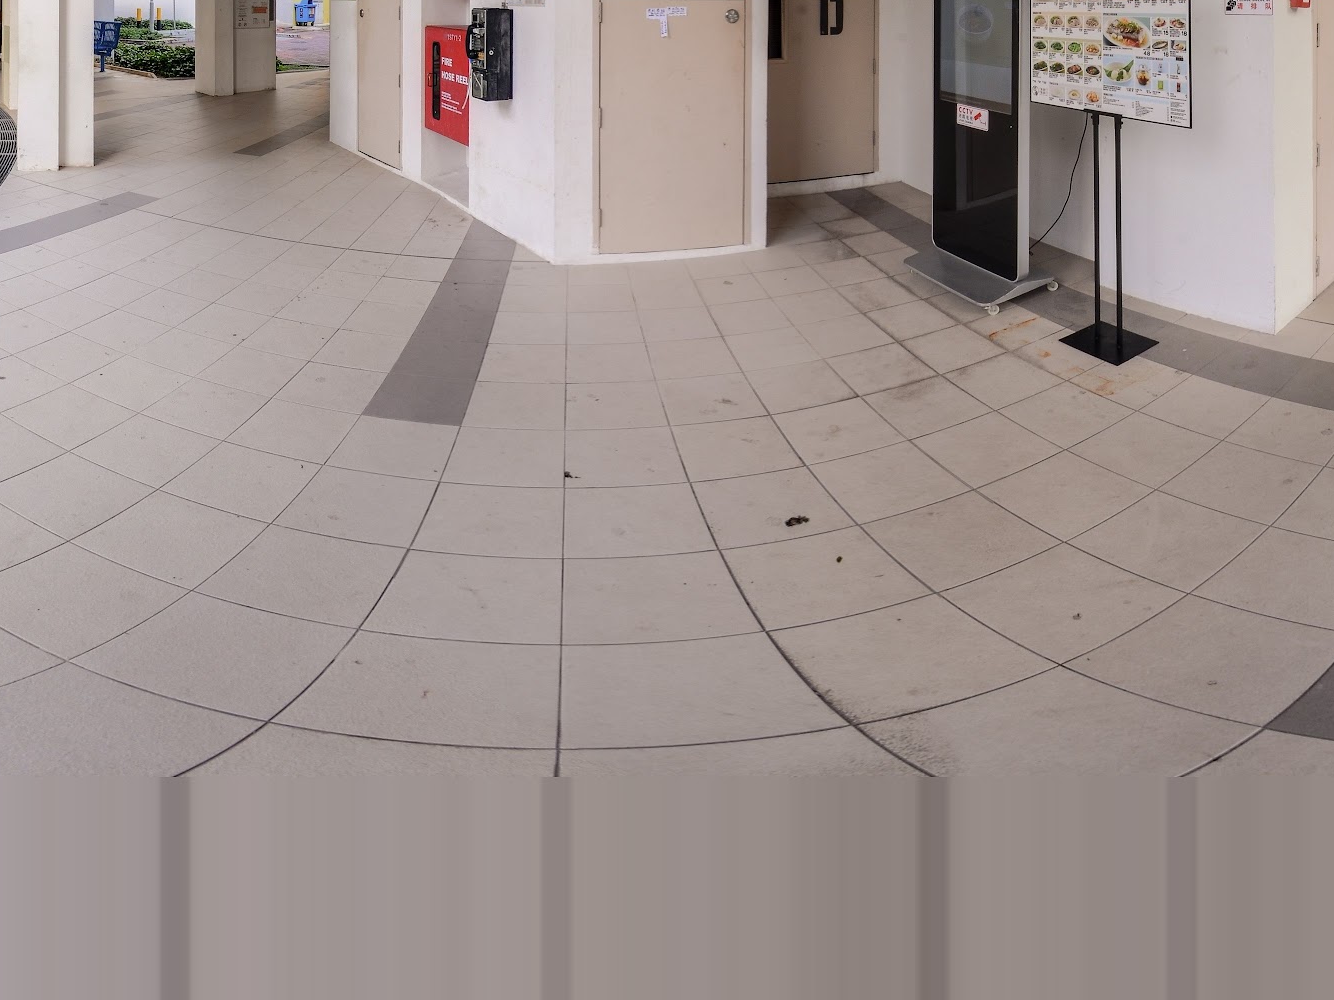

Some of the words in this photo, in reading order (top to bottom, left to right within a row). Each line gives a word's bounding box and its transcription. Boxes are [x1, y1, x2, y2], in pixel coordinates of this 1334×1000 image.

[442, 57, 452, 67] FIRE
[442, 71, 455, 82] HOSE
[456, 75, 468, 85] REEL
